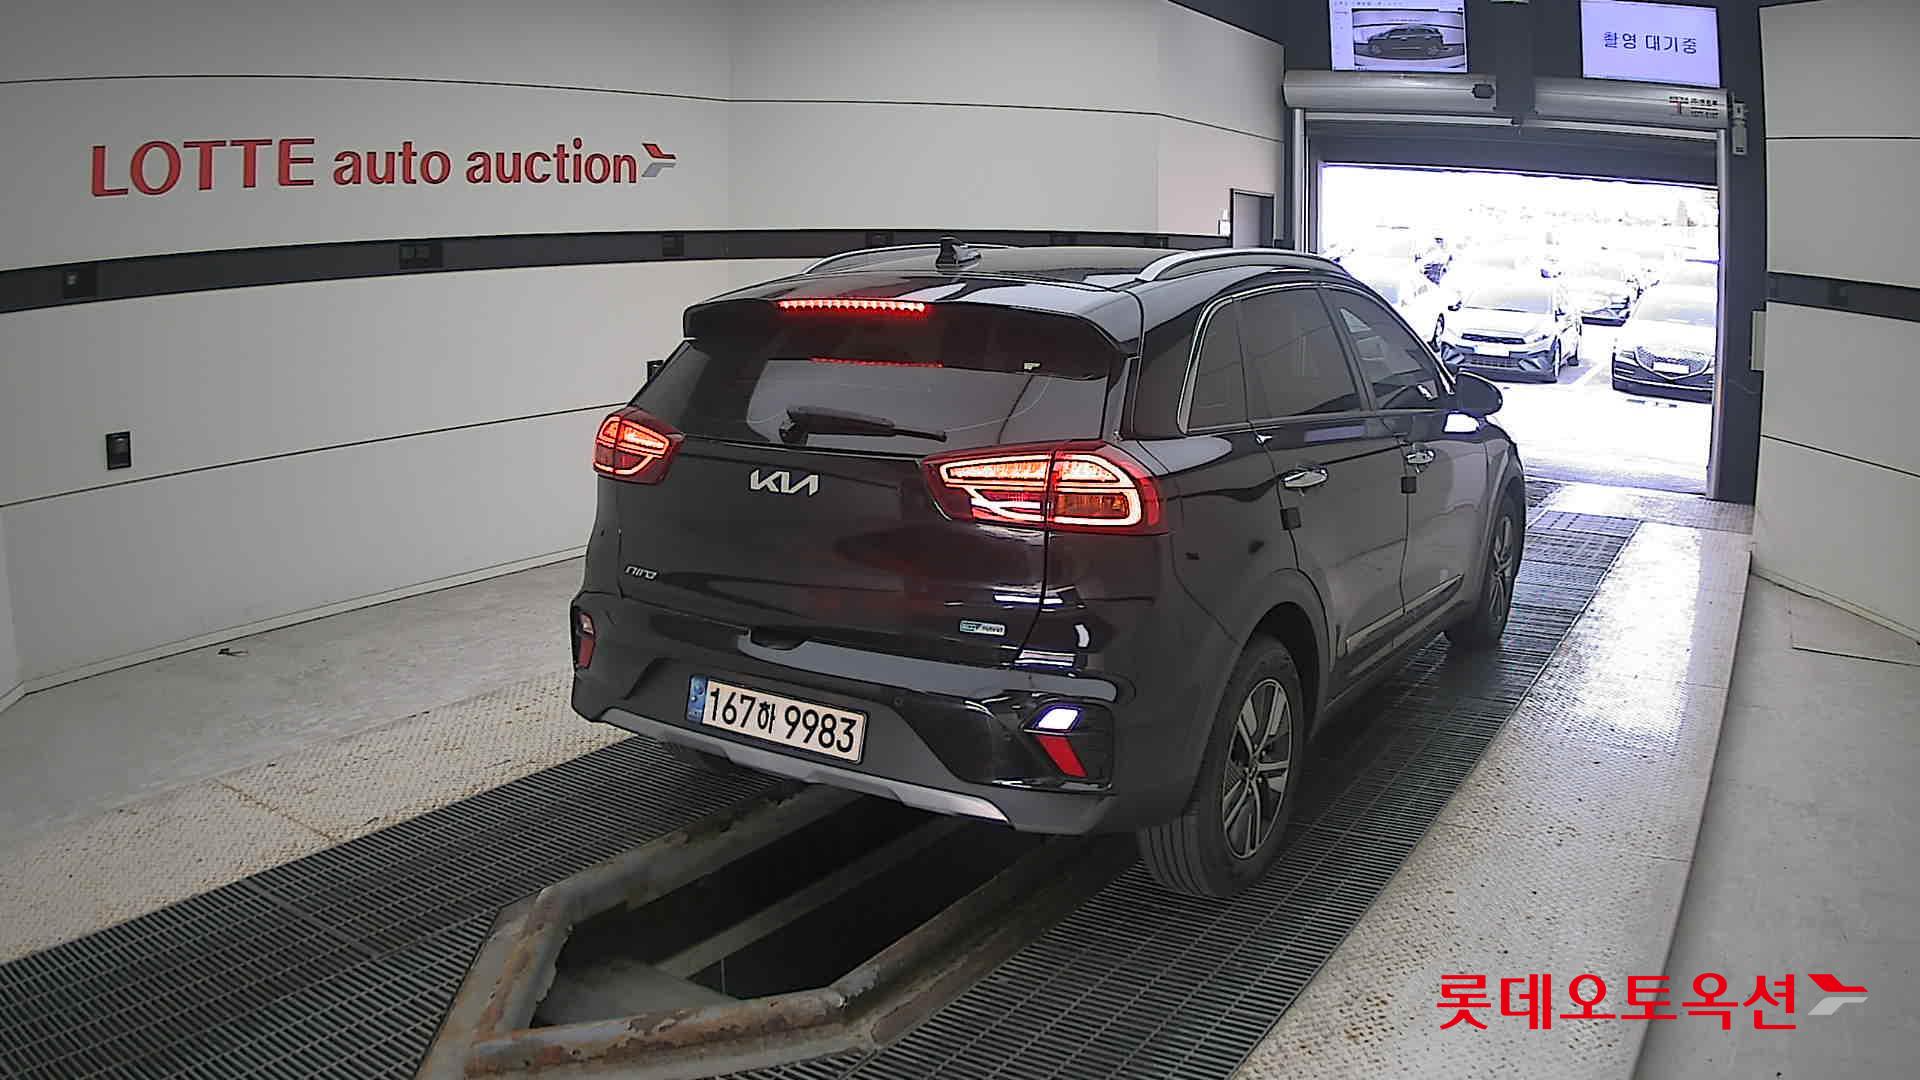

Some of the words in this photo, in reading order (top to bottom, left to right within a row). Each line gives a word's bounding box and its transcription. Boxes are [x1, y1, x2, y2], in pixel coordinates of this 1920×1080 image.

[1645, 34, 1697, 55] 대기중
[90, 138, 316, 198] LOTTE
[332, 140, 452, 186] auto
[464, 137, 639, 184] auction
[750, 469, 819, 496] KIA
[710, 687, 776, 735] 167하
[784, 705, 858, 753] 9983
